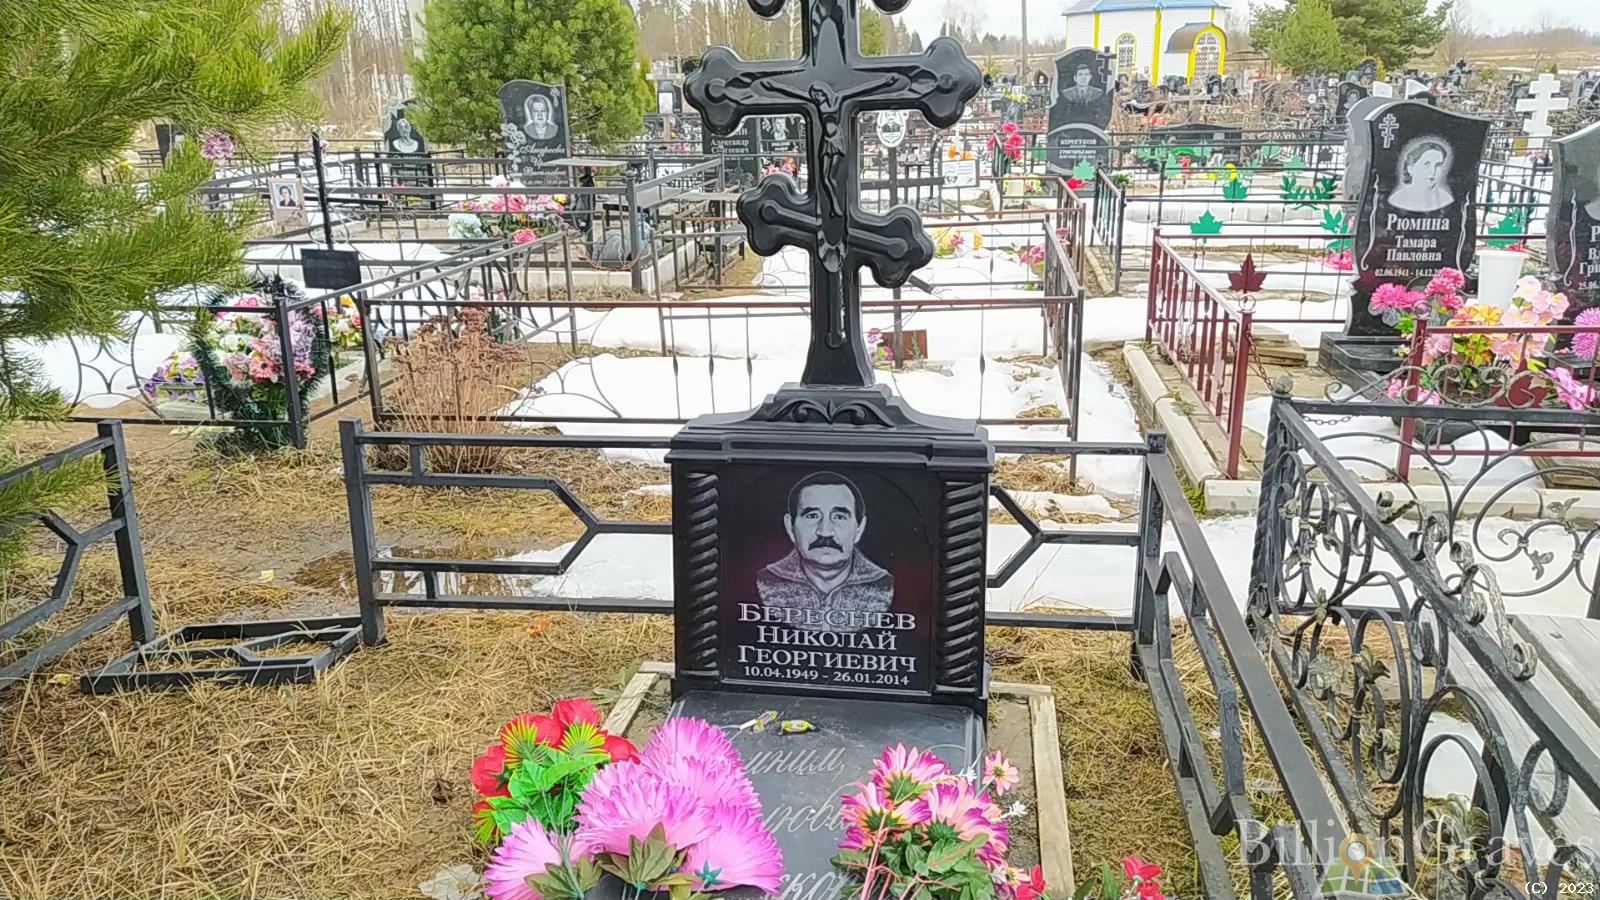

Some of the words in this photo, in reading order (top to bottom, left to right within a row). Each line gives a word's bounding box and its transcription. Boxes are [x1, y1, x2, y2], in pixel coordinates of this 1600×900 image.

[1386, 213, 1450, 231] Рюмина
[1395, 235, 1437, 251] Тамара
[1386, 248, 1442, 261] Павловна
[737, 602, 917, 630] БЕРЕСНЕВ
[737, 645, 917, 673] ГЕОРГИЕВИЧ
[744, 666, 819, 680] 10.04.1949
[832, 671, 910, 686] 26.01.2014
